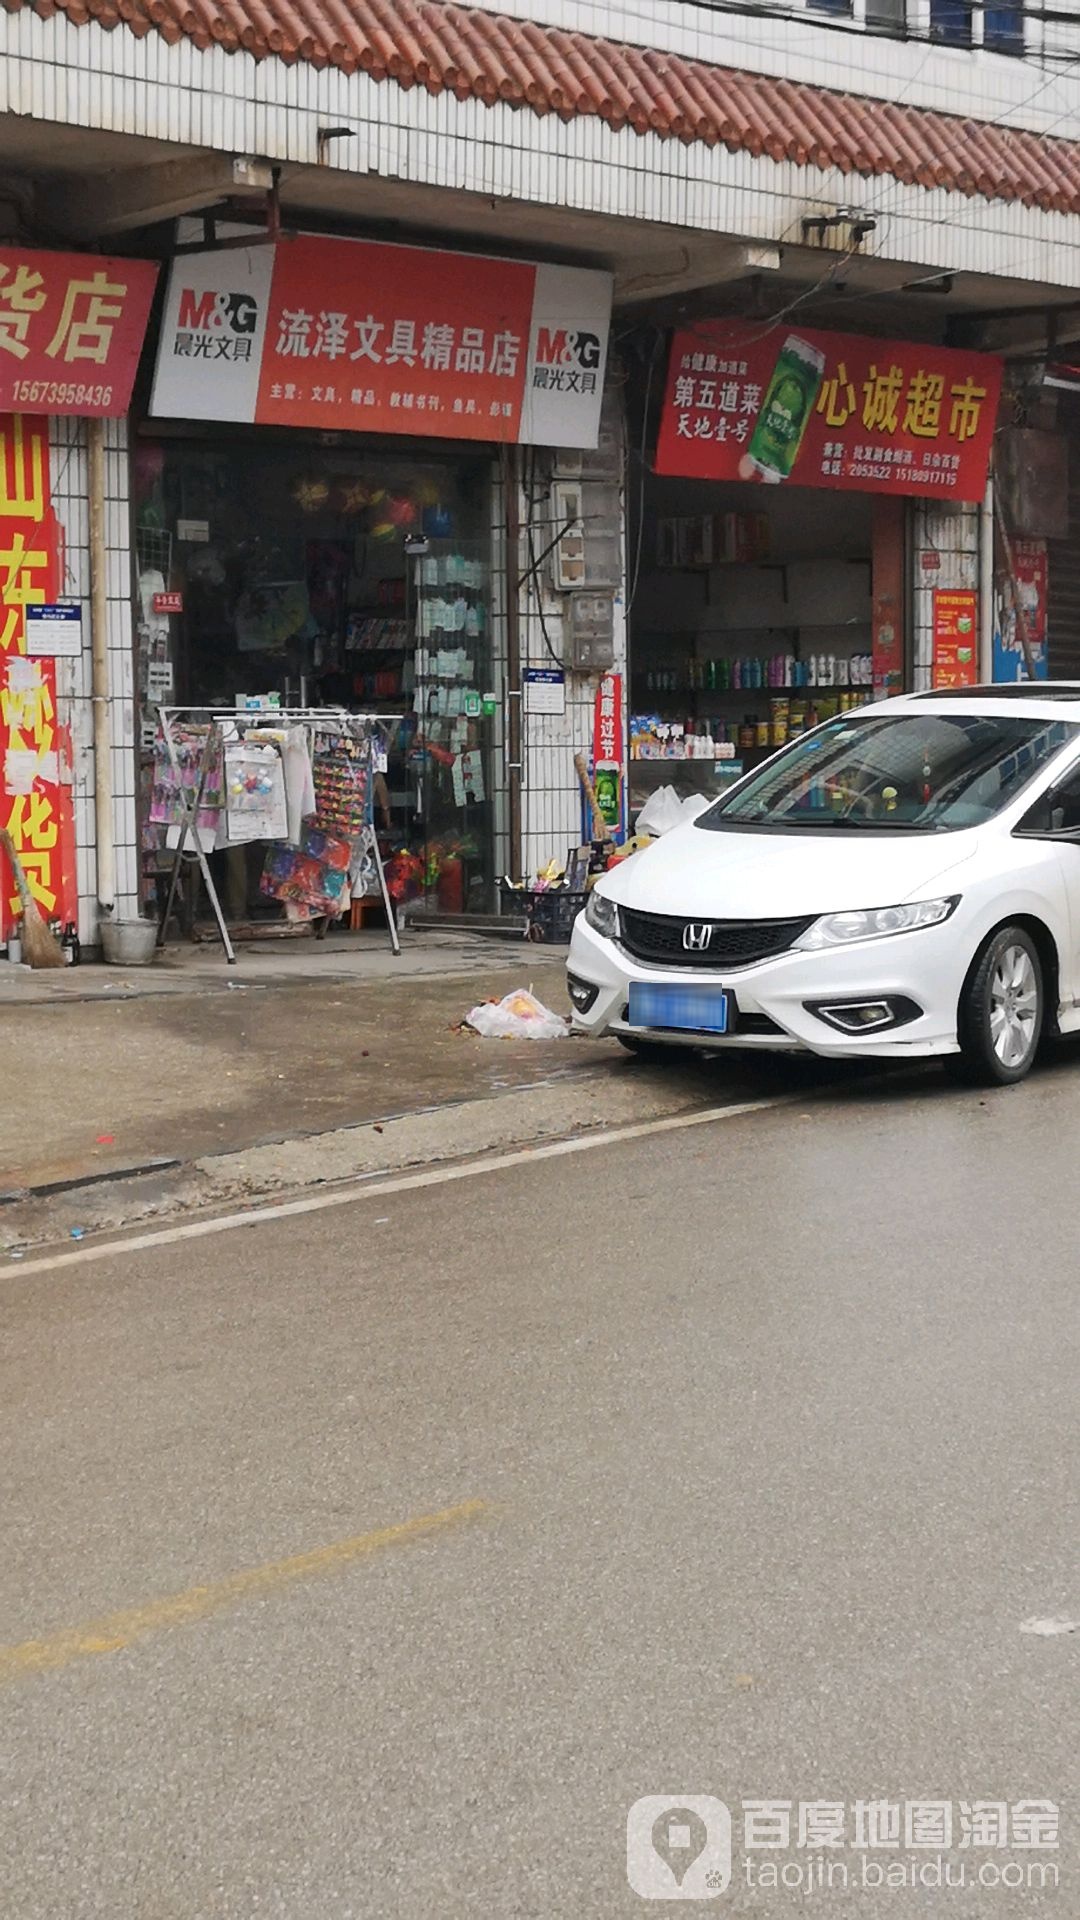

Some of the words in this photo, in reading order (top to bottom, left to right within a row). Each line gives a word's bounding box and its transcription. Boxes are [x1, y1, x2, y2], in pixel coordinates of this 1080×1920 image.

[178, 288, 257, 333] M&G
[174, 333, 252, 362] 晨光文具
[275, 308, 521, 377] 流泽文具精品店
[535, 327, 600, 369] M&G
[13, 380, 113, 406] 15673958436
[532, 366, 597, 395] 晨光文具
[673, 375, 762, 415] 第五道菜
[816, 361, 987, 442] 心诚超市
[677, 413, 749, 443] 天地壹号
